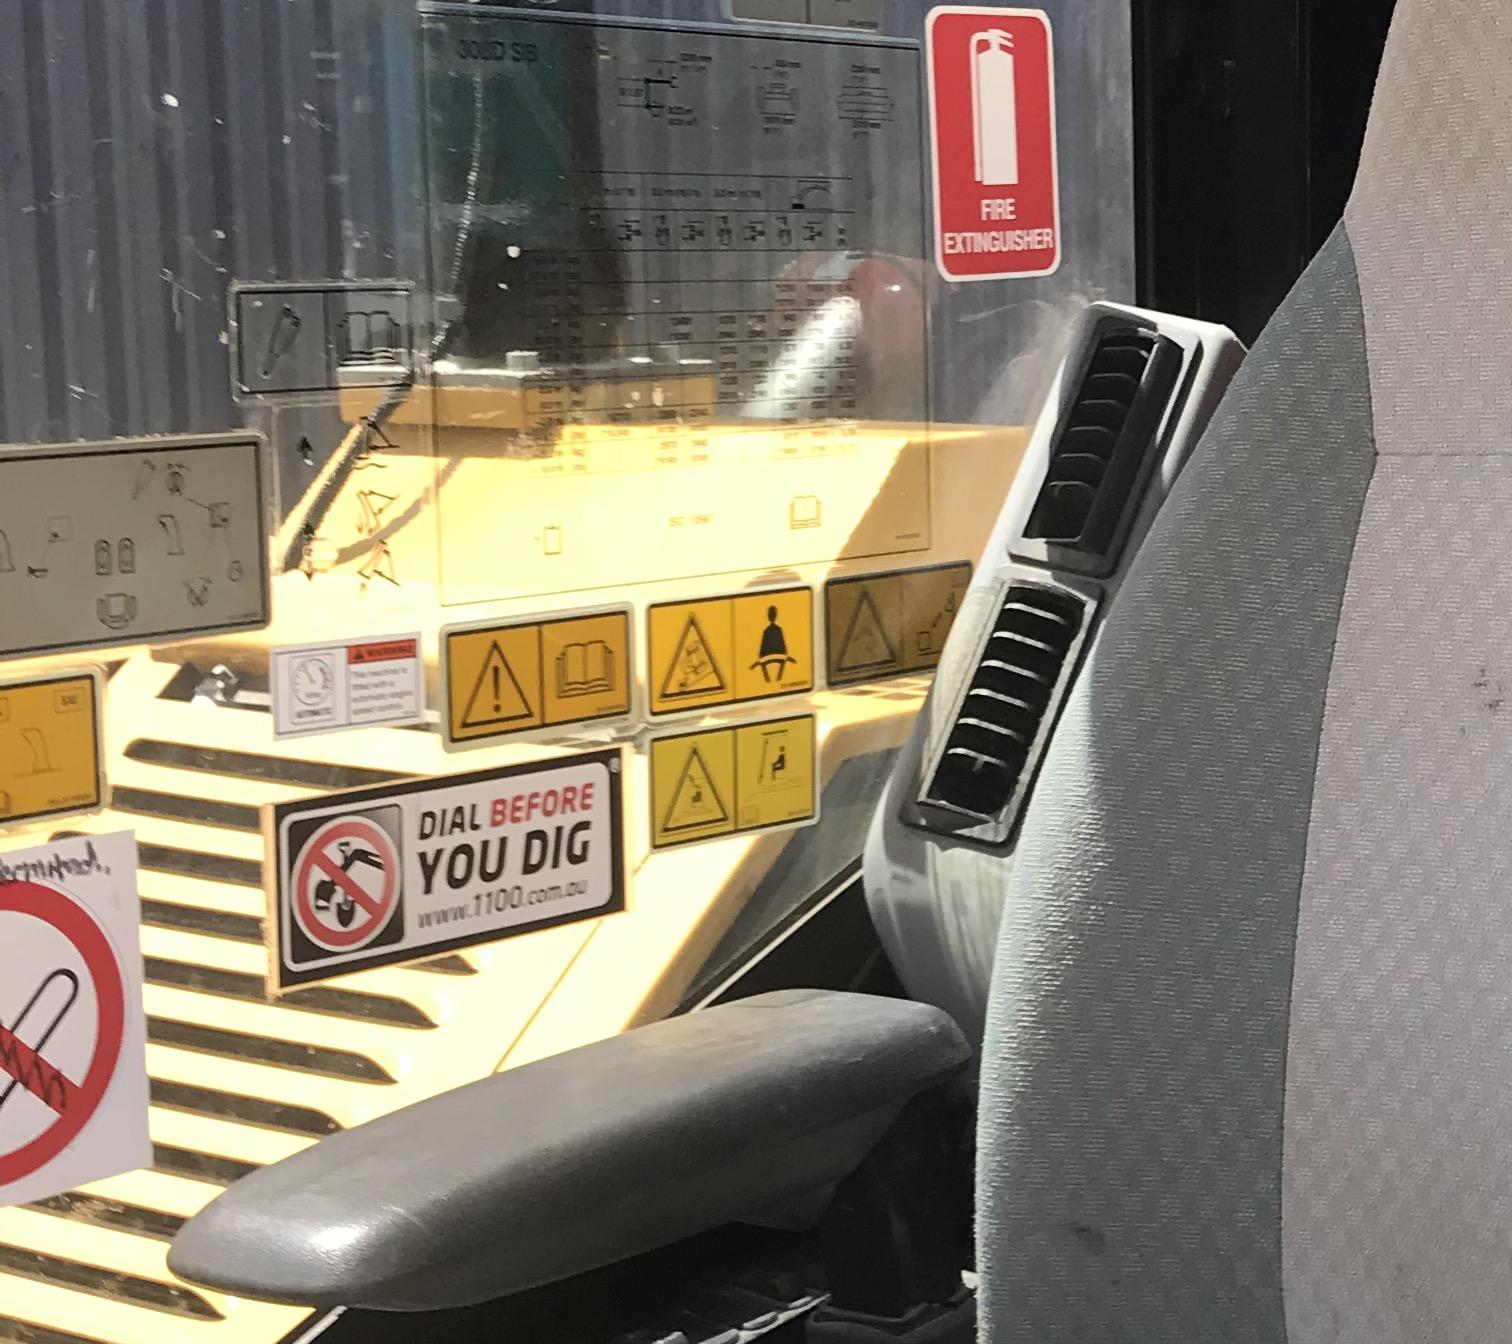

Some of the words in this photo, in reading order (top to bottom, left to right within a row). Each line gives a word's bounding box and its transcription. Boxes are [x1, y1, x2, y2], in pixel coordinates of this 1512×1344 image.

[980, 198, 1016, 221] FIRE
[943, 228, 1055, 255] EXTINGUISHER
[418, 803, 481, 840] DIAL
[489, 782, 595, 828] BEFORE
[417, 836, 508, 895] YOU
[521, 820, 592, 876] DIG
[417, 879, 588, 929] www.1100.com.au
